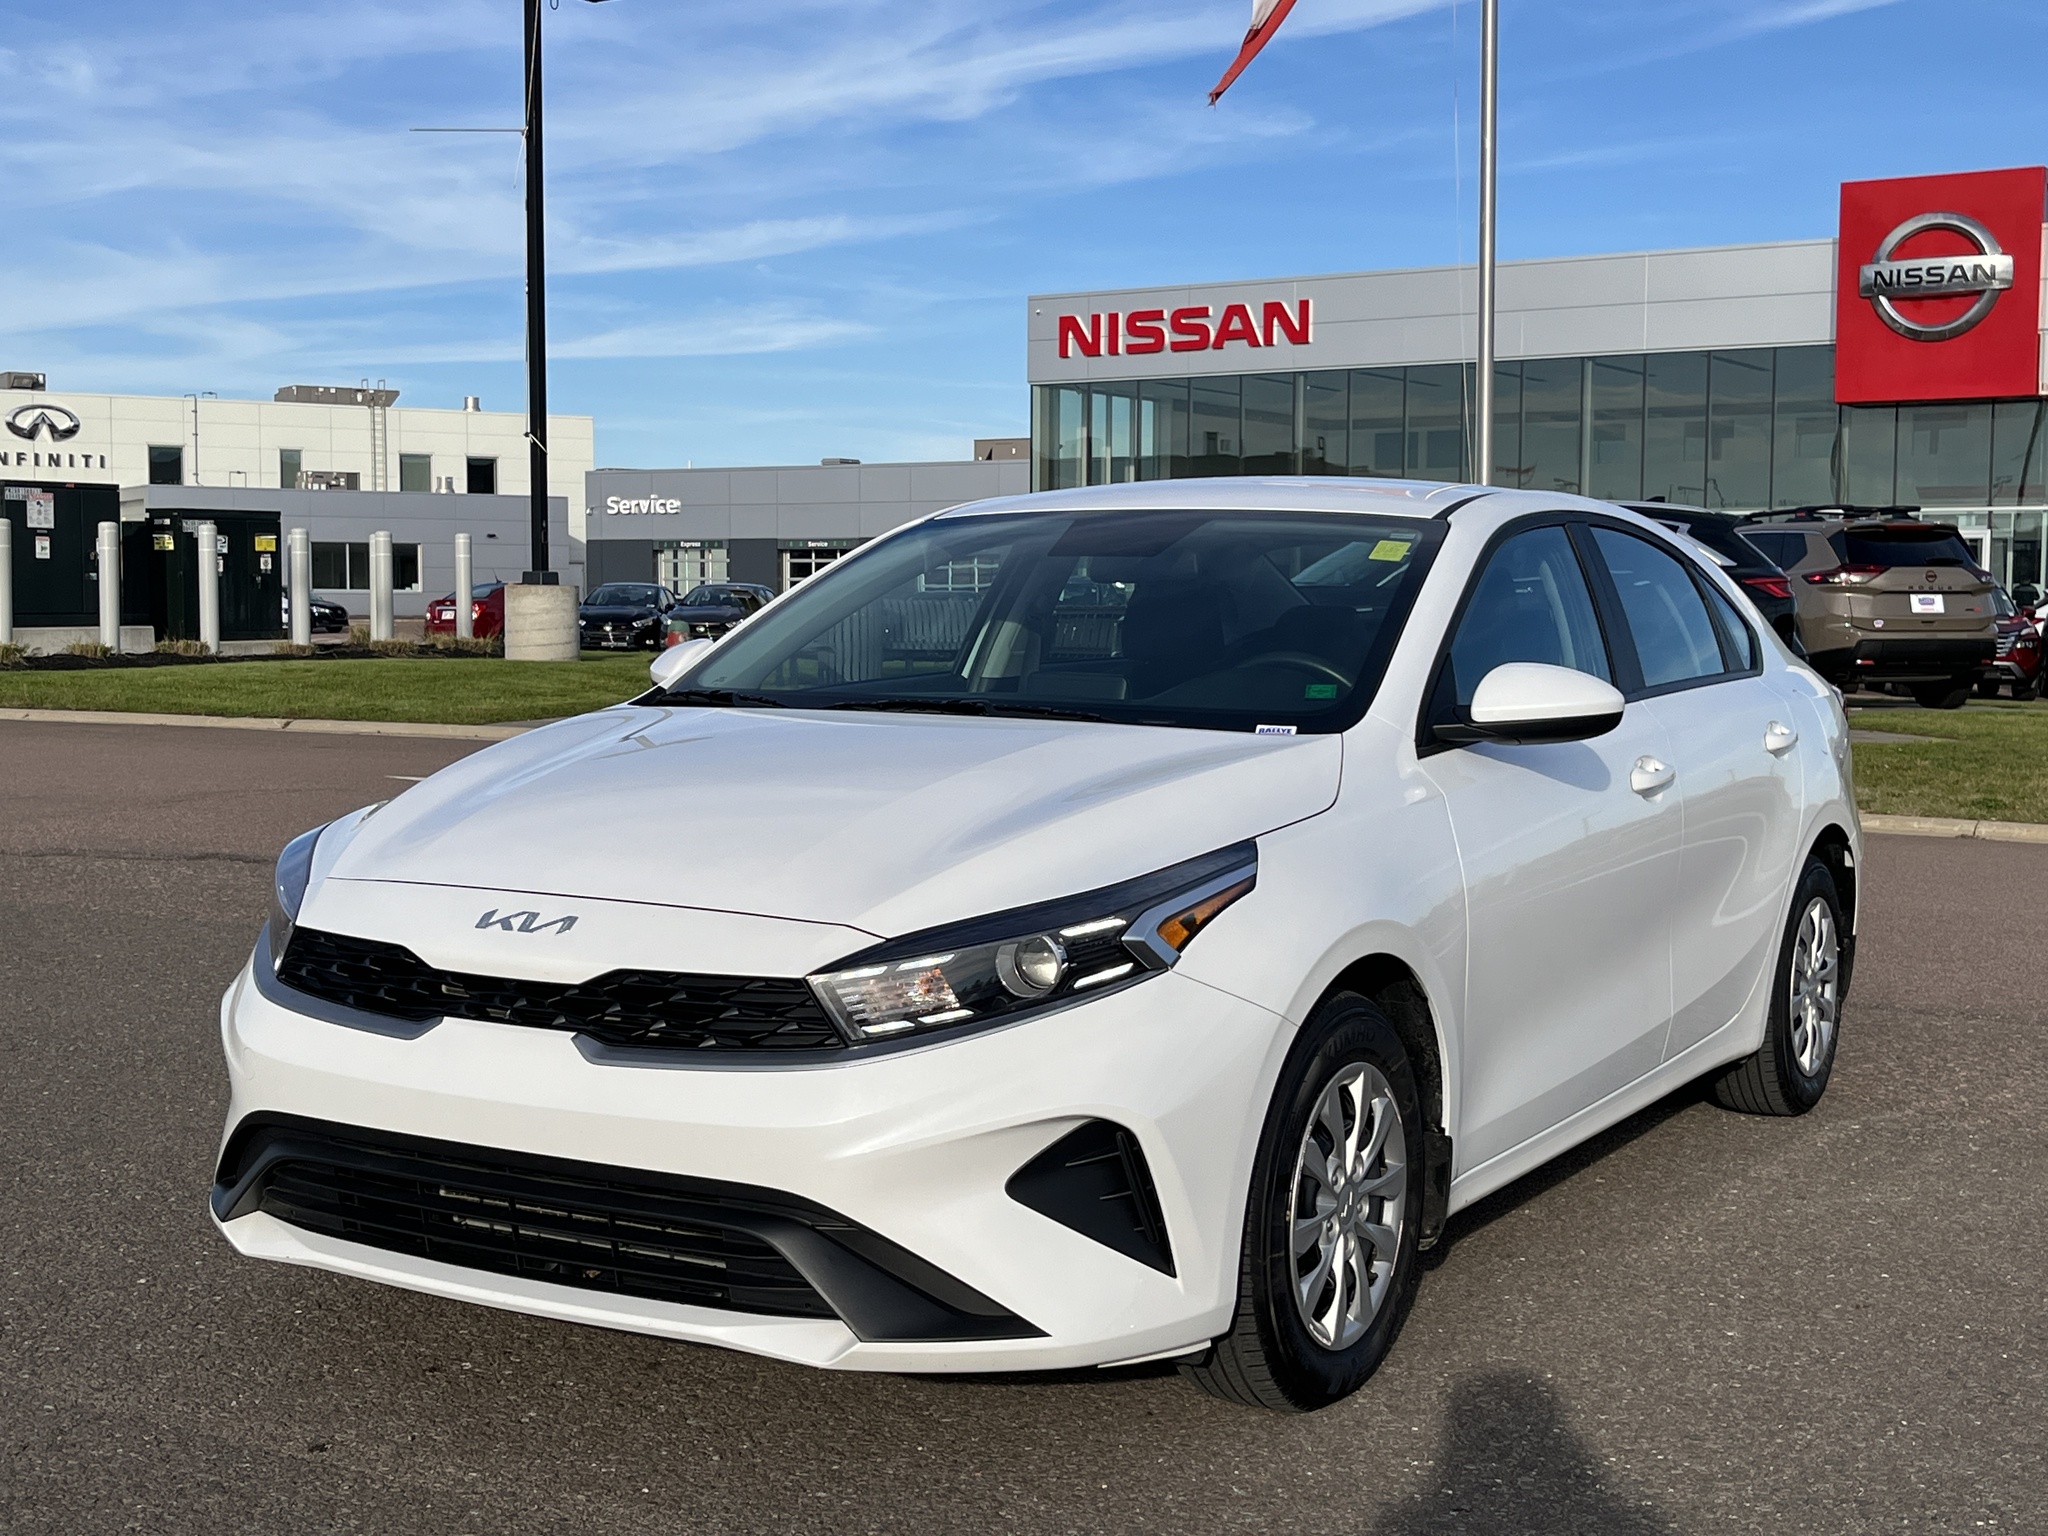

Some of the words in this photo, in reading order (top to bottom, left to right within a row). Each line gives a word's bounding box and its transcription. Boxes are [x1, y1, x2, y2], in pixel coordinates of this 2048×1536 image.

[1872, 264, 1997, 289] NISSAN
[1058, 299, 1313, 359] NISSAN
[606, 494, 682, 515] Service
